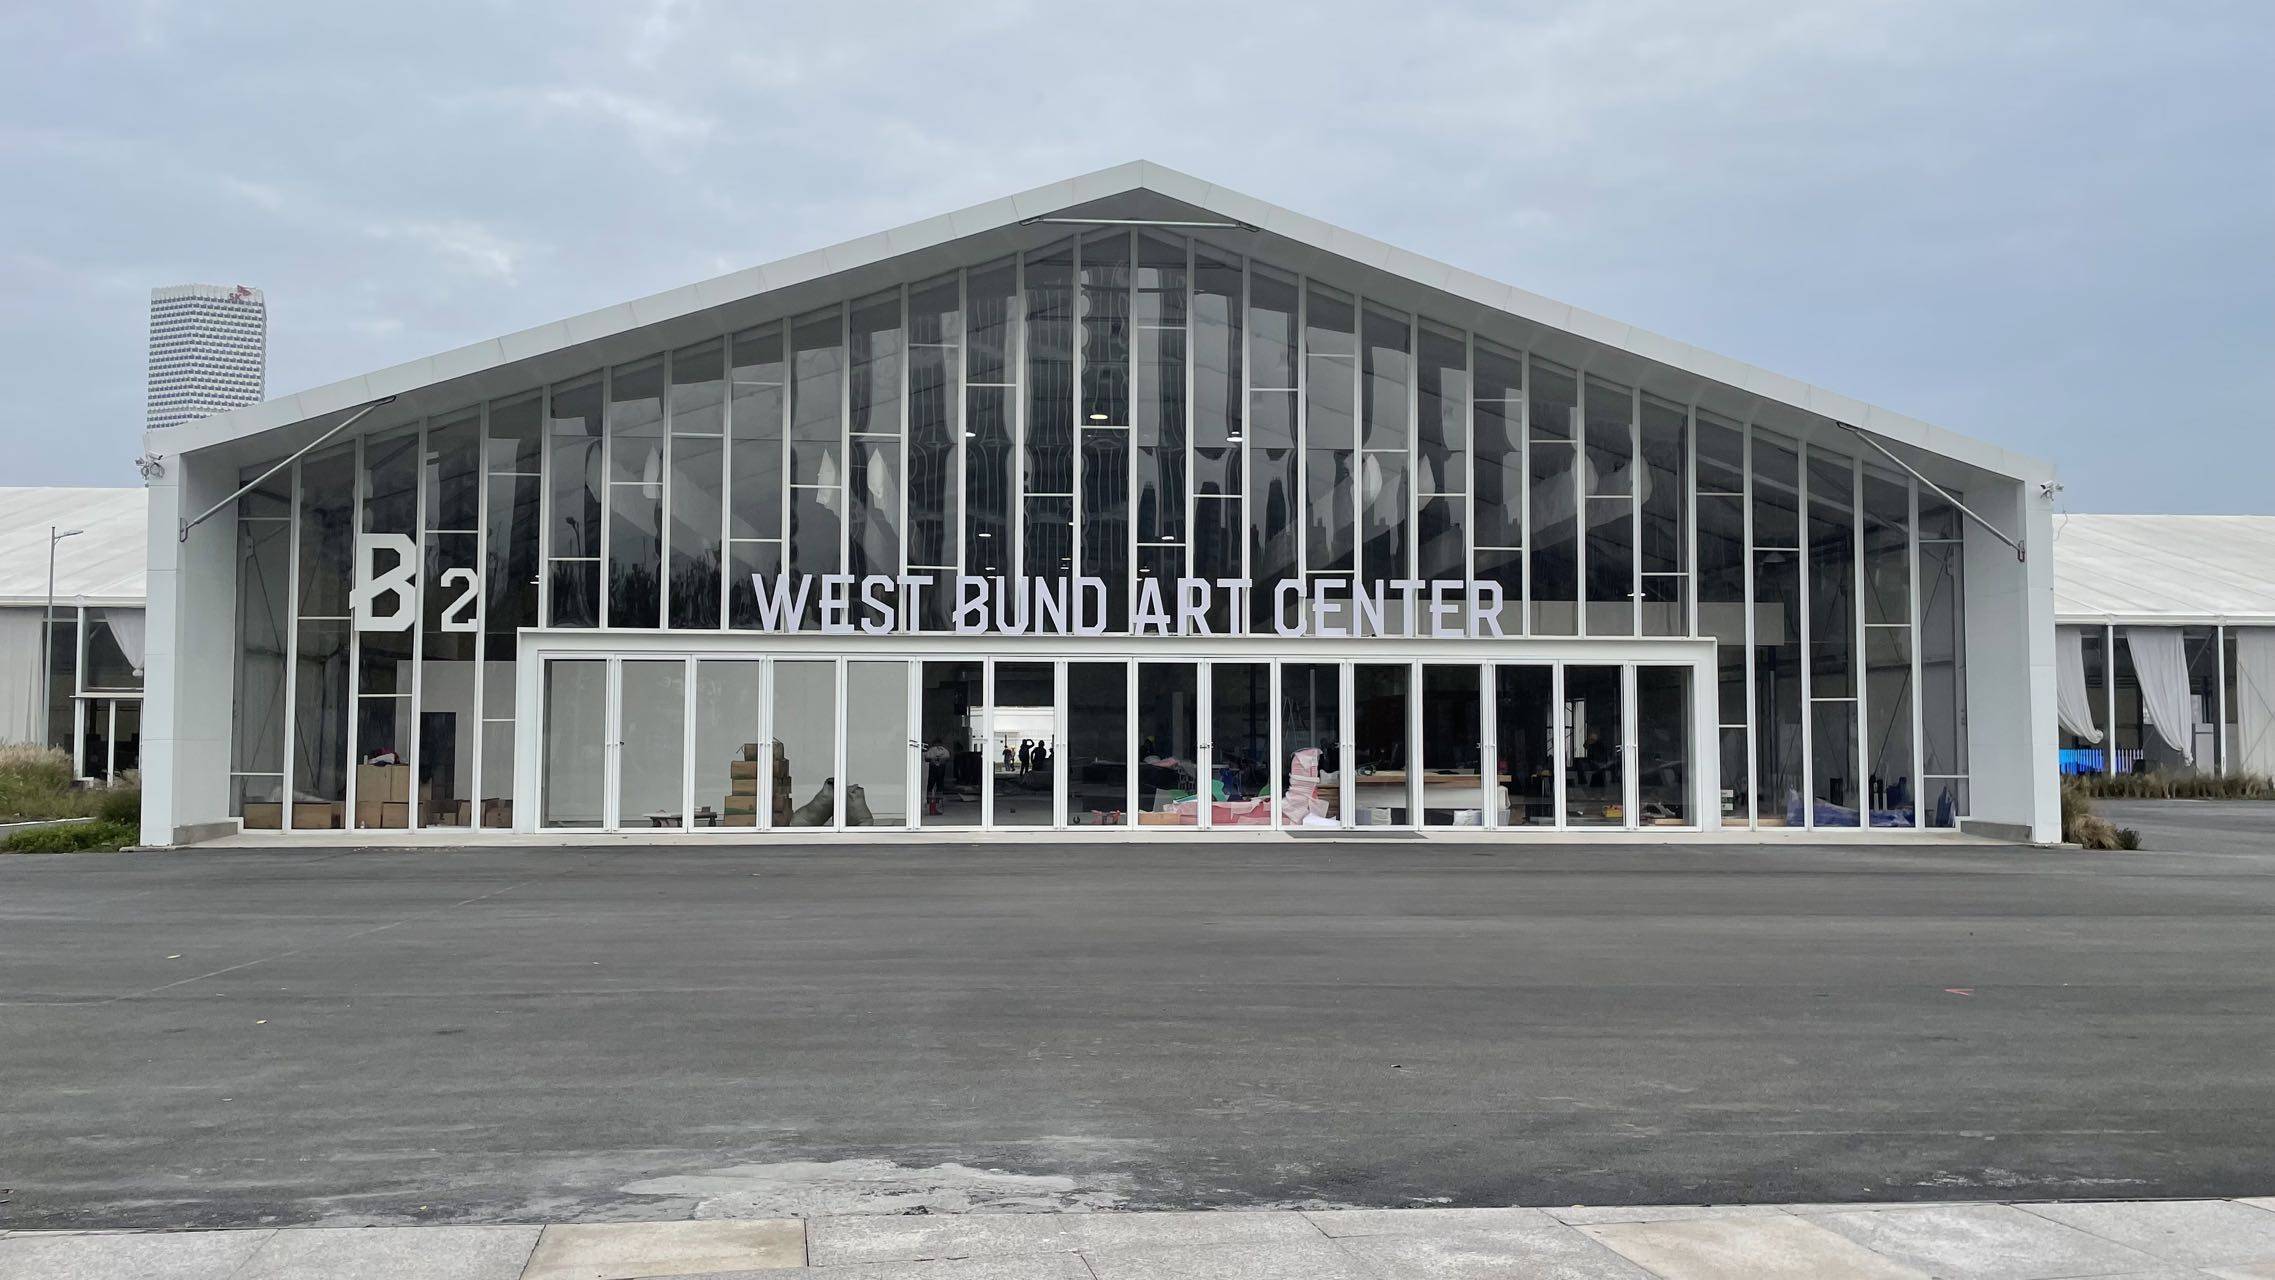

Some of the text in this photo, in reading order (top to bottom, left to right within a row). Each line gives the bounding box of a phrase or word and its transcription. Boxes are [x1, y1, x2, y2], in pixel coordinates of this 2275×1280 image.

[752, 573, 1504, 638] WEST BUND ART CENTER
